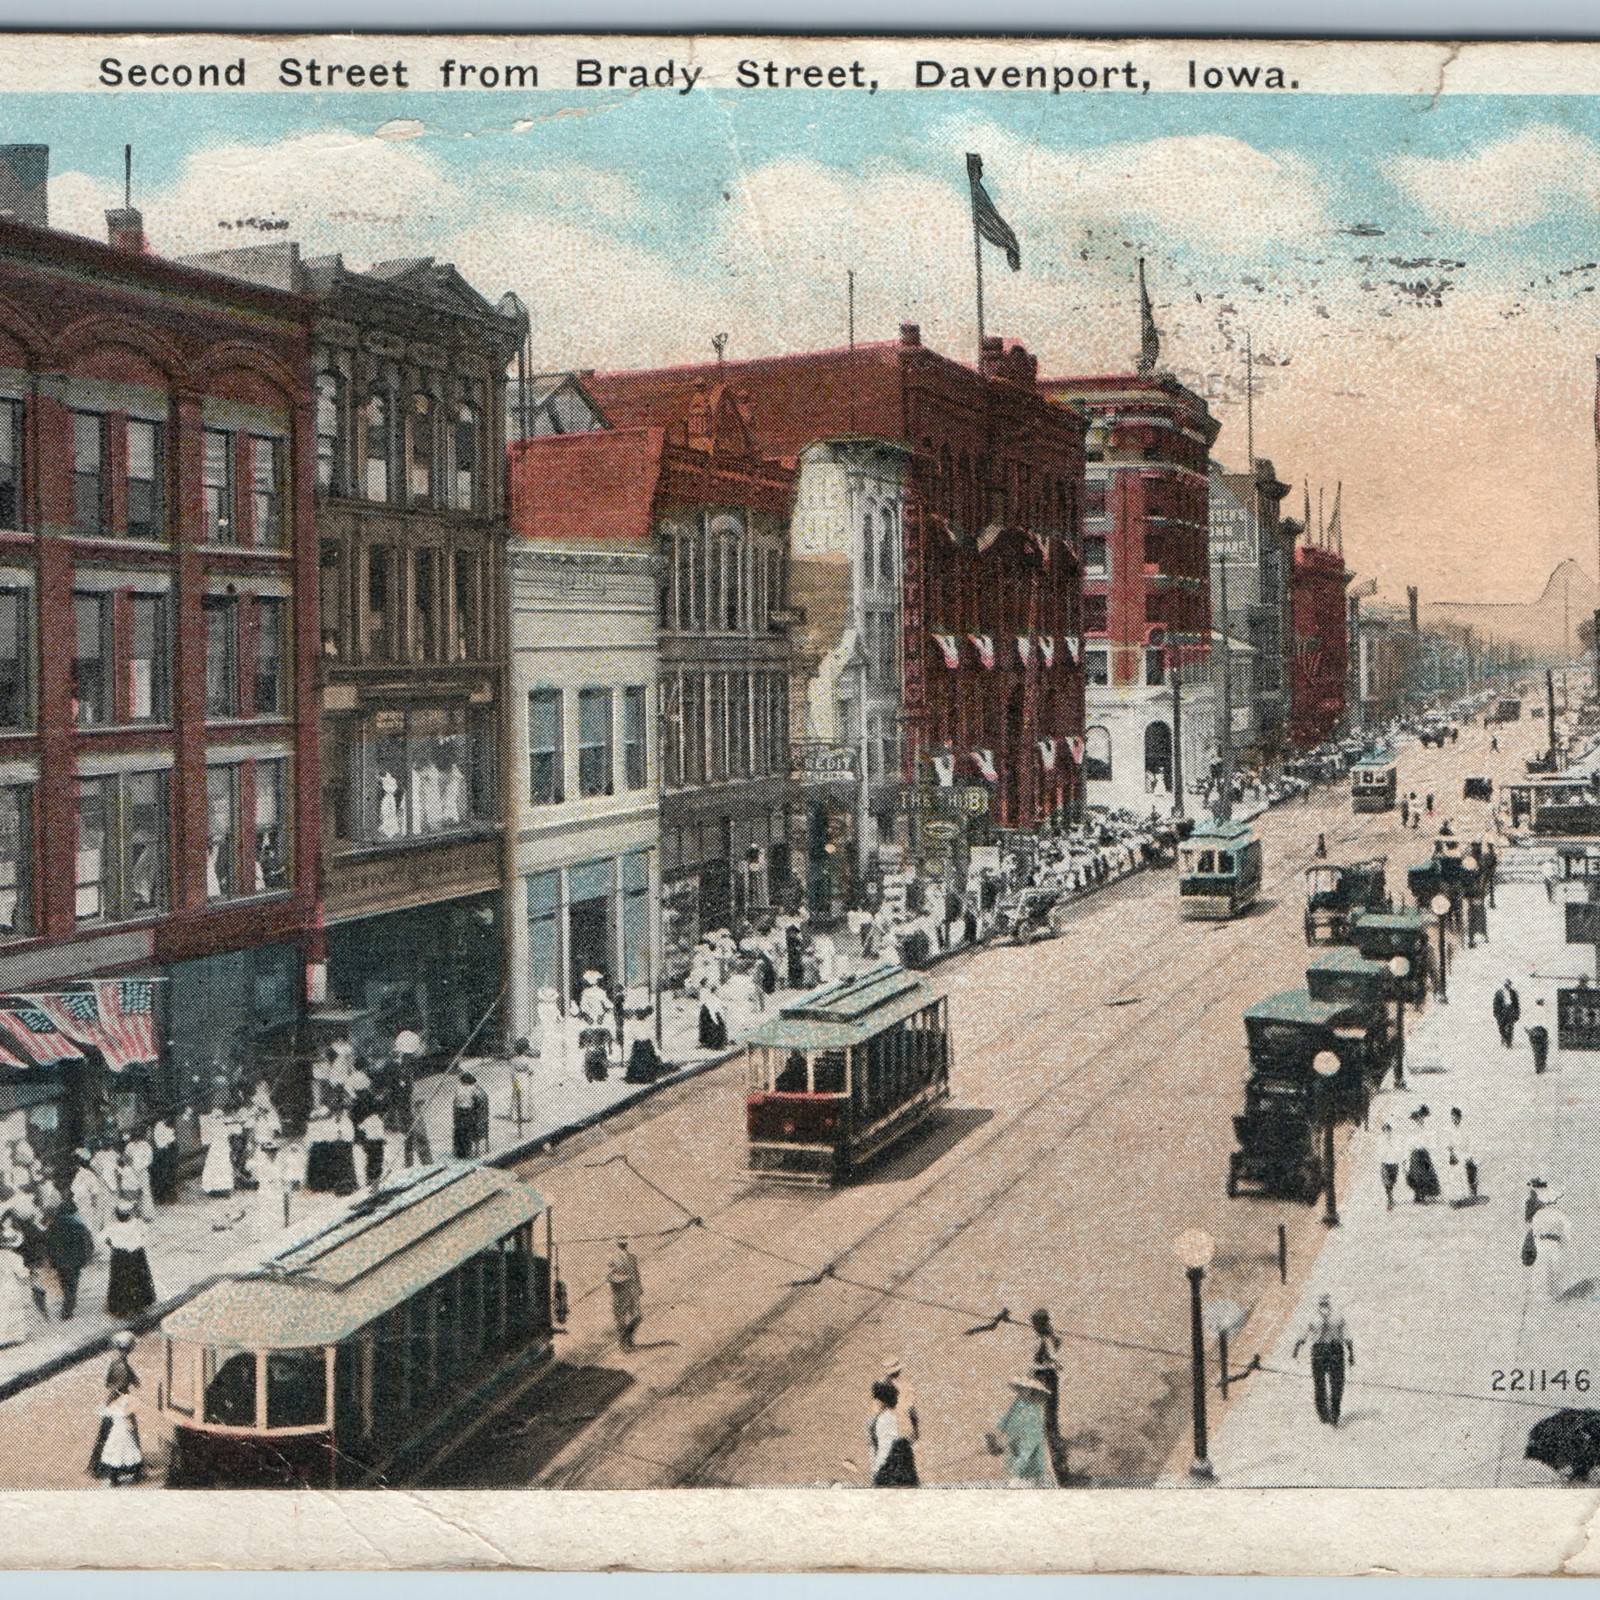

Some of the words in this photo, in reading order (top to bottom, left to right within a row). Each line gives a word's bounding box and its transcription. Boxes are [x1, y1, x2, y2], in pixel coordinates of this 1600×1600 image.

[100, 59, 246, 89] Second
[280, 59, 410, 89] Street
[440, 60, 539, 89] from
[577, 60, 702, 97] Brady
[737, 60, 879, 97] Street,
[916, 61, 1151, 97] Davenport,
[1189, 61, 1301, 91] Iowa.
[897, 790, 931, 810] THE
[1491, 1368, 1591, 1392] 221146
